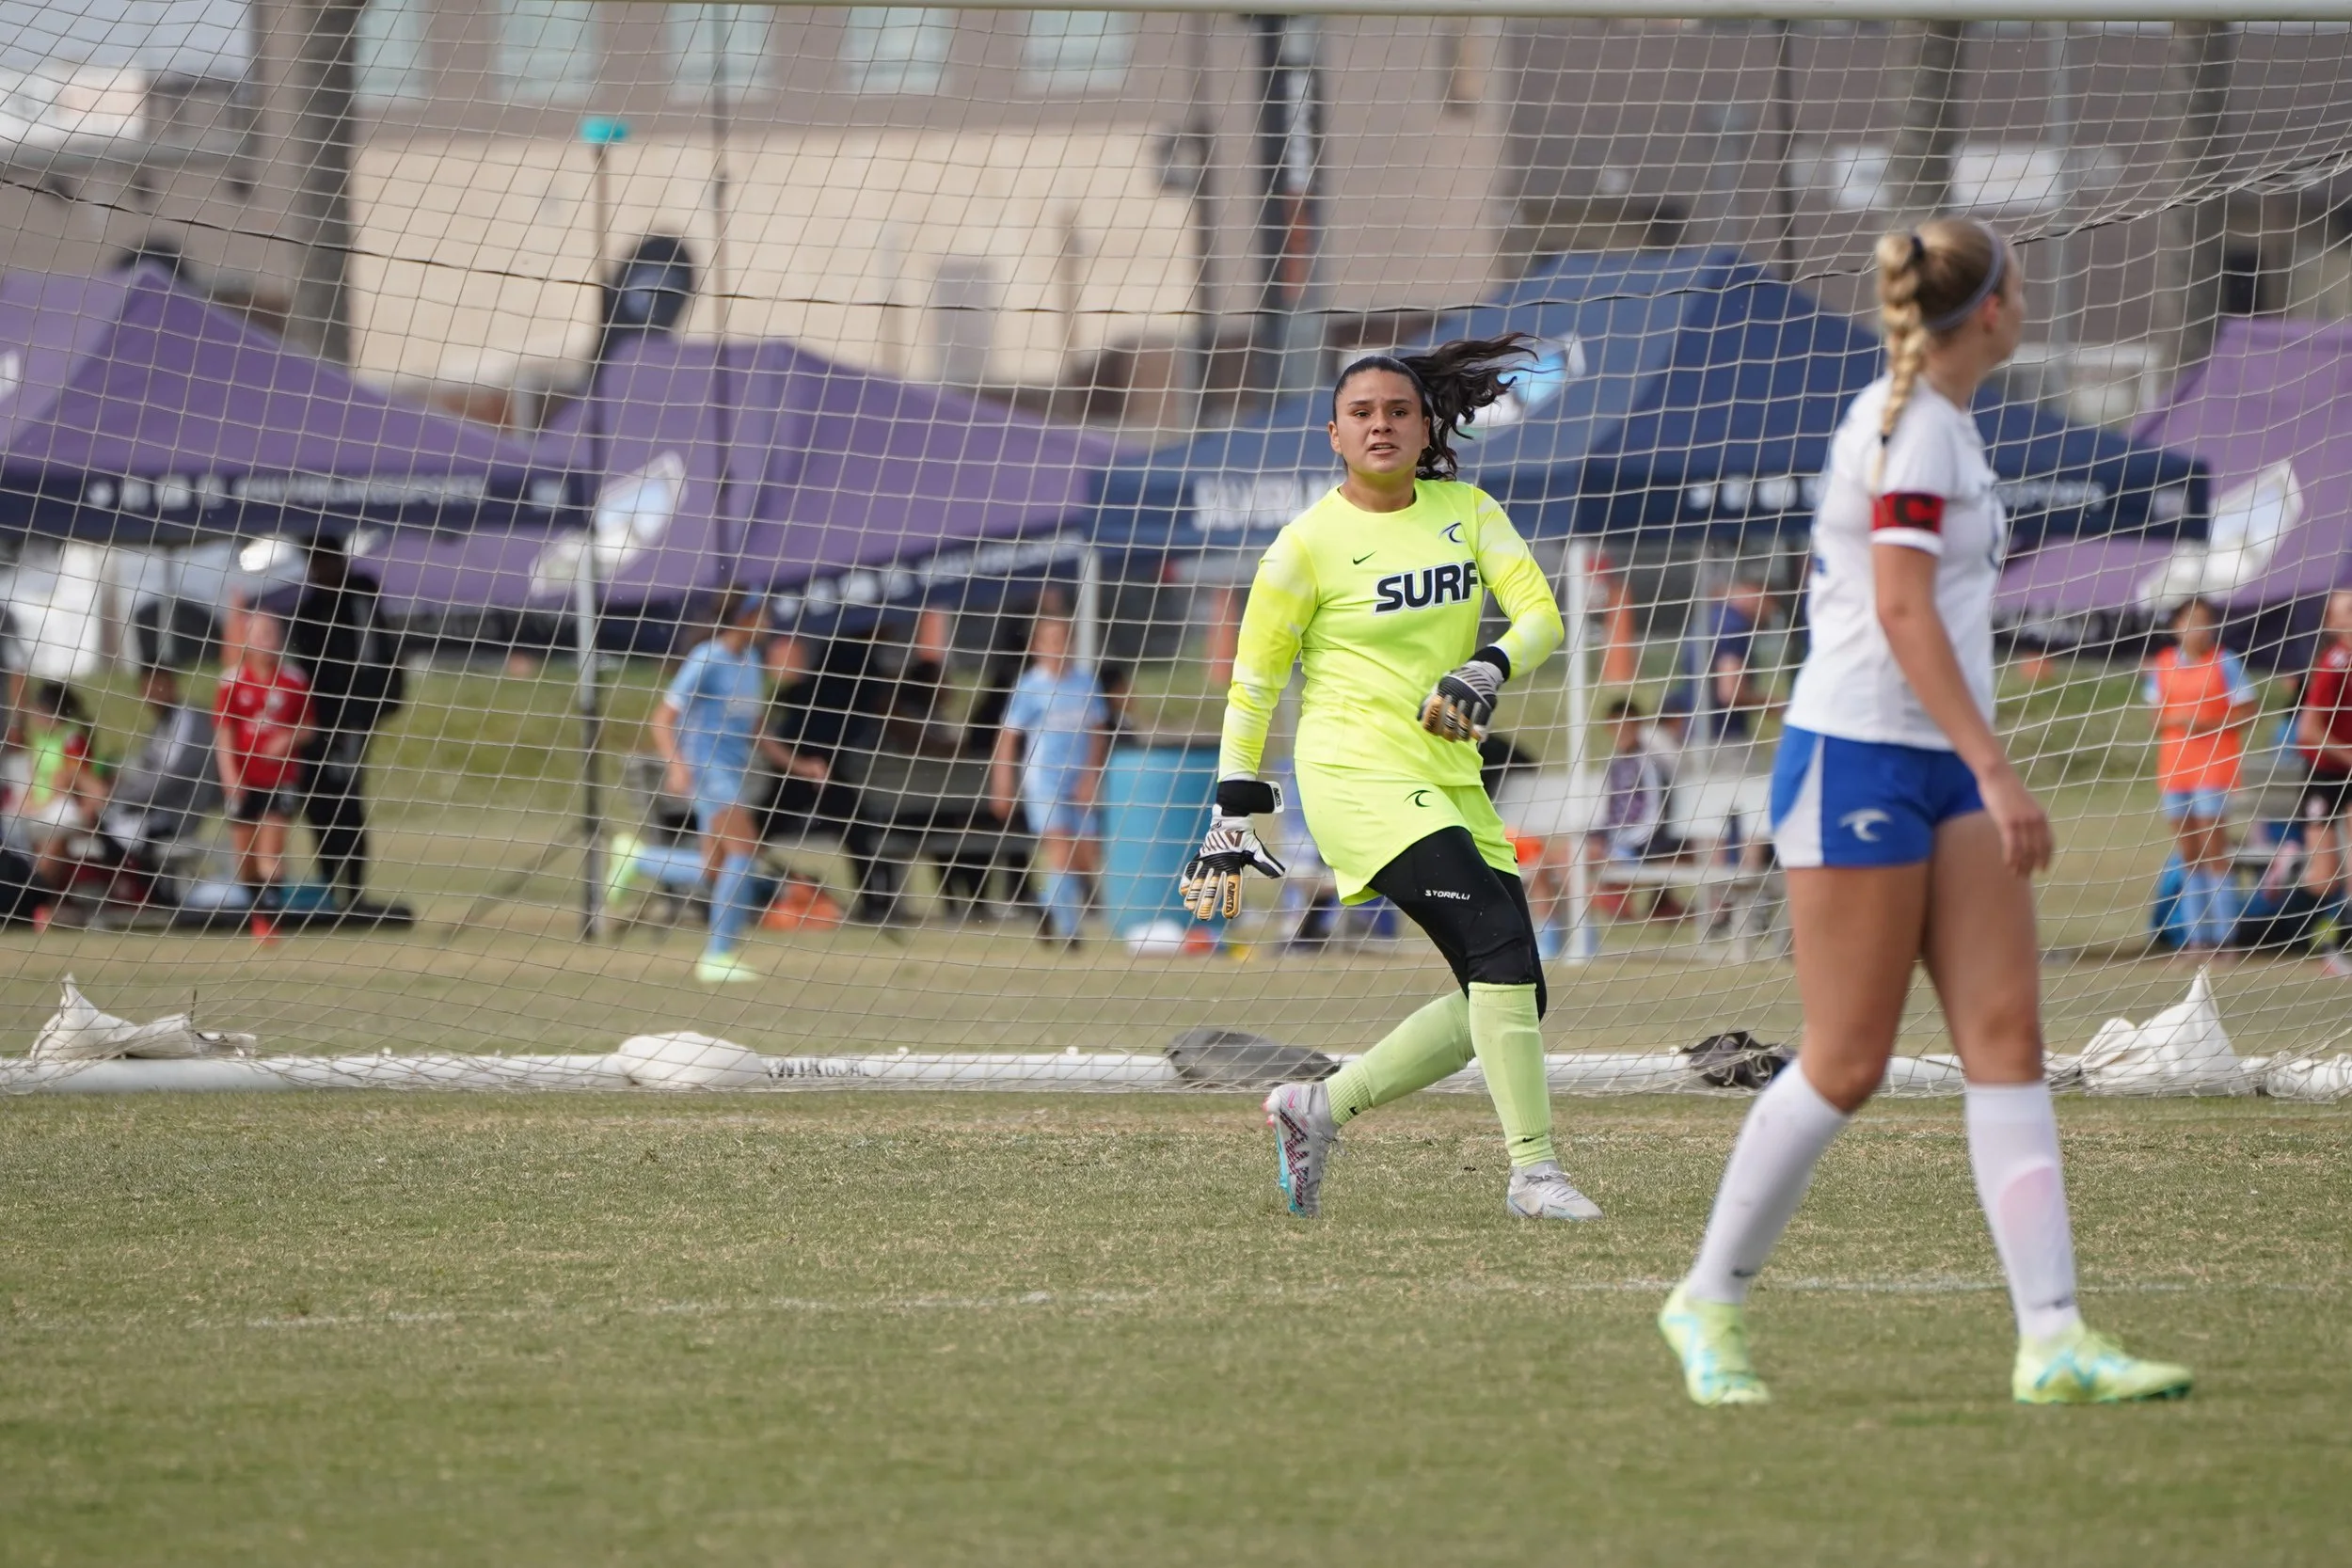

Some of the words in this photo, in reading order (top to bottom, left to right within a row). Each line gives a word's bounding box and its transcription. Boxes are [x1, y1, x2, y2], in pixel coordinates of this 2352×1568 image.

[1893, 493, 1934, 530] C
[1374, 560, 1479, 614] SURF
[1424, 889, 1470, 900] STORELLI
